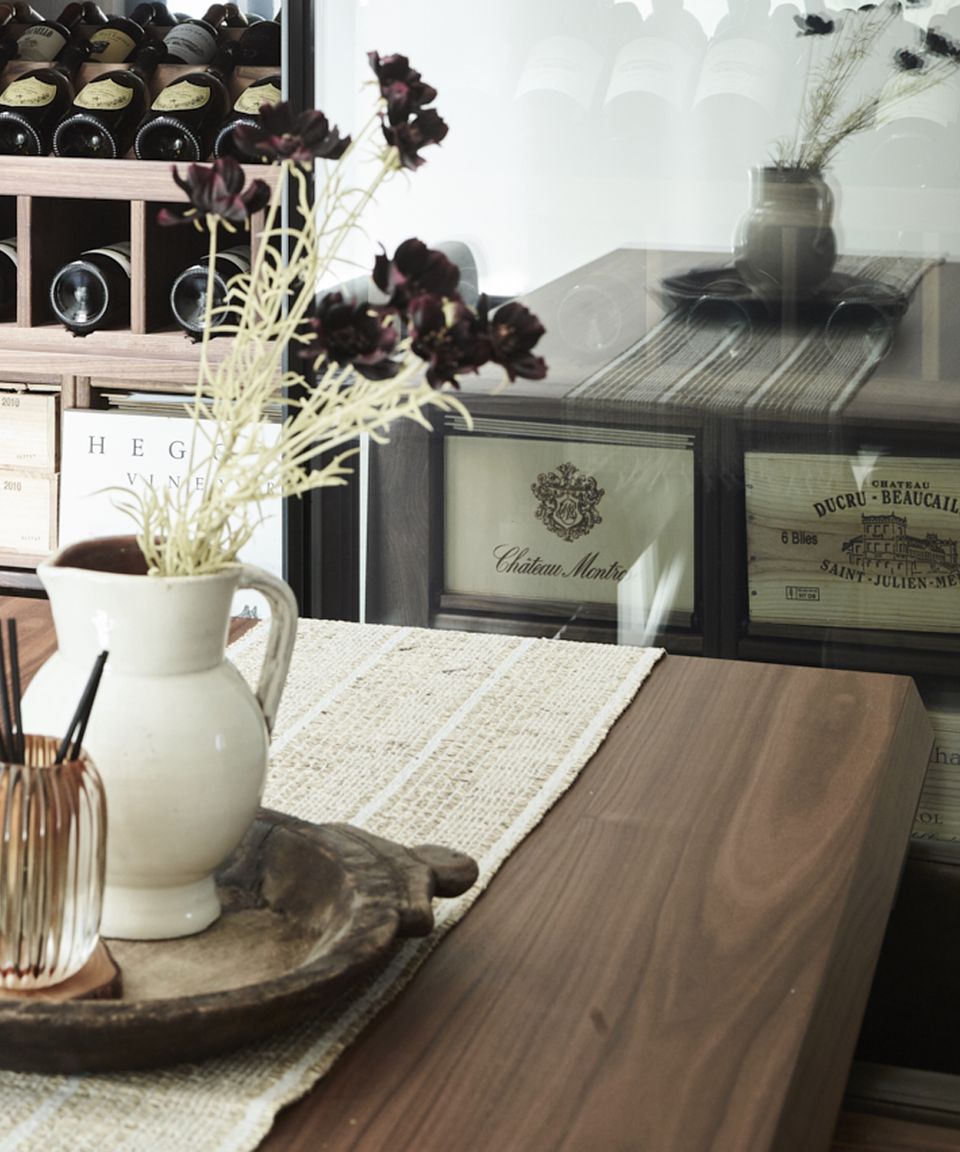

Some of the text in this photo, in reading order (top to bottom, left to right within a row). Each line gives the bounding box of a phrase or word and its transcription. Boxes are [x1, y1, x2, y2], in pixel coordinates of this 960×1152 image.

[126, 472, 276, 495] VINER
[871, 480, 930, 489] CHATEAU
[881, 489, 960, 515] BEAUCAIL
[781, 531, 788, 544] 6
[492, 544, 628, 582] Château Montro
[929, 747, 960, 766] ha
[913, 812, 944, 825] OL
